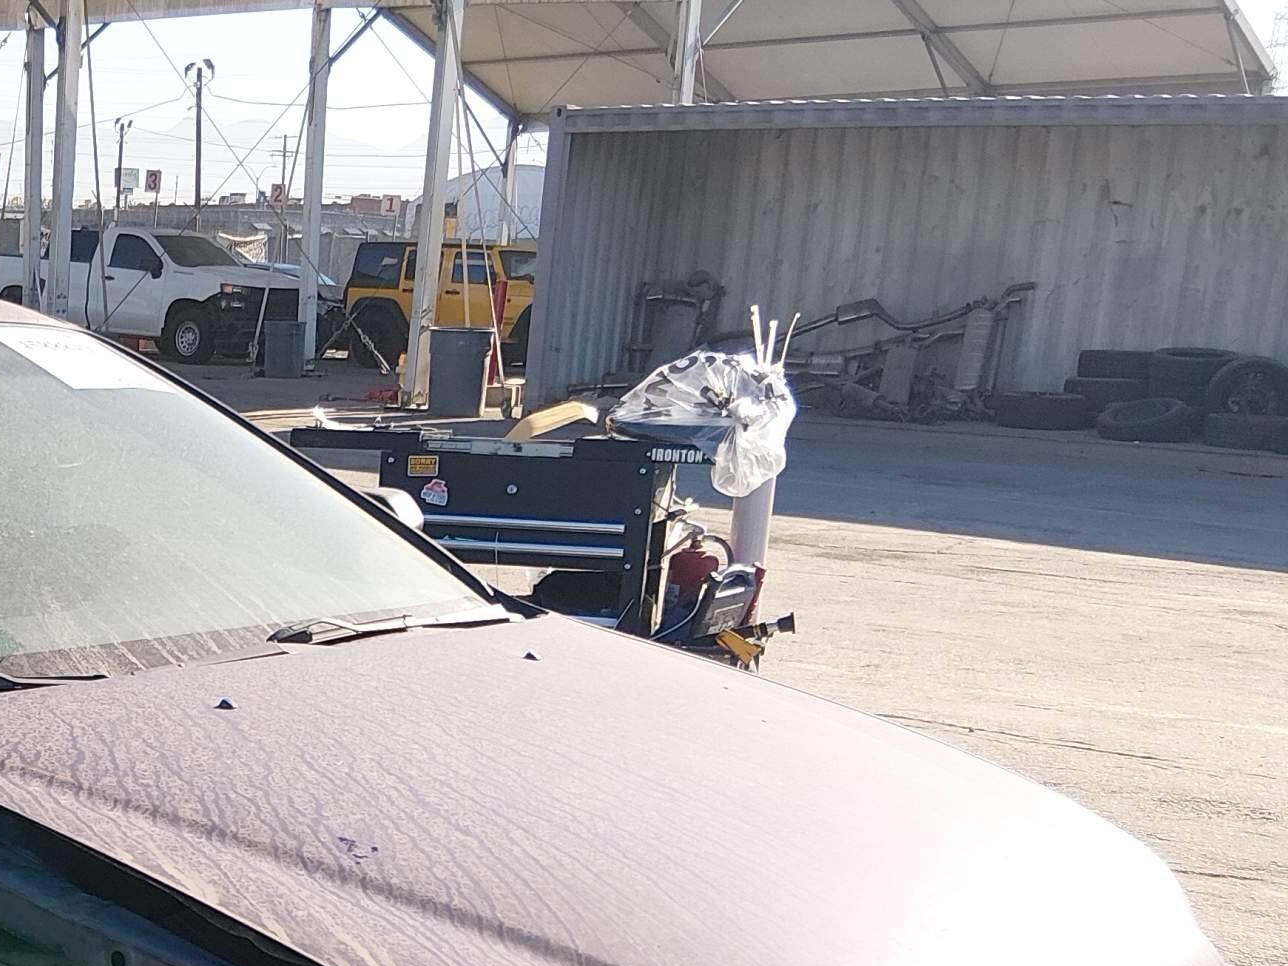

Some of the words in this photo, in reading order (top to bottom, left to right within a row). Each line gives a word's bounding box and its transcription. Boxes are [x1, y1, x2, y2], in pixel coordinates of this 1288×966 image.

[148, 173, 158, 190] 3
[274, 185, 283, 203] 2
[385, 197, 395, 213] 1
[651, 448, 703, 463] IRONTON
